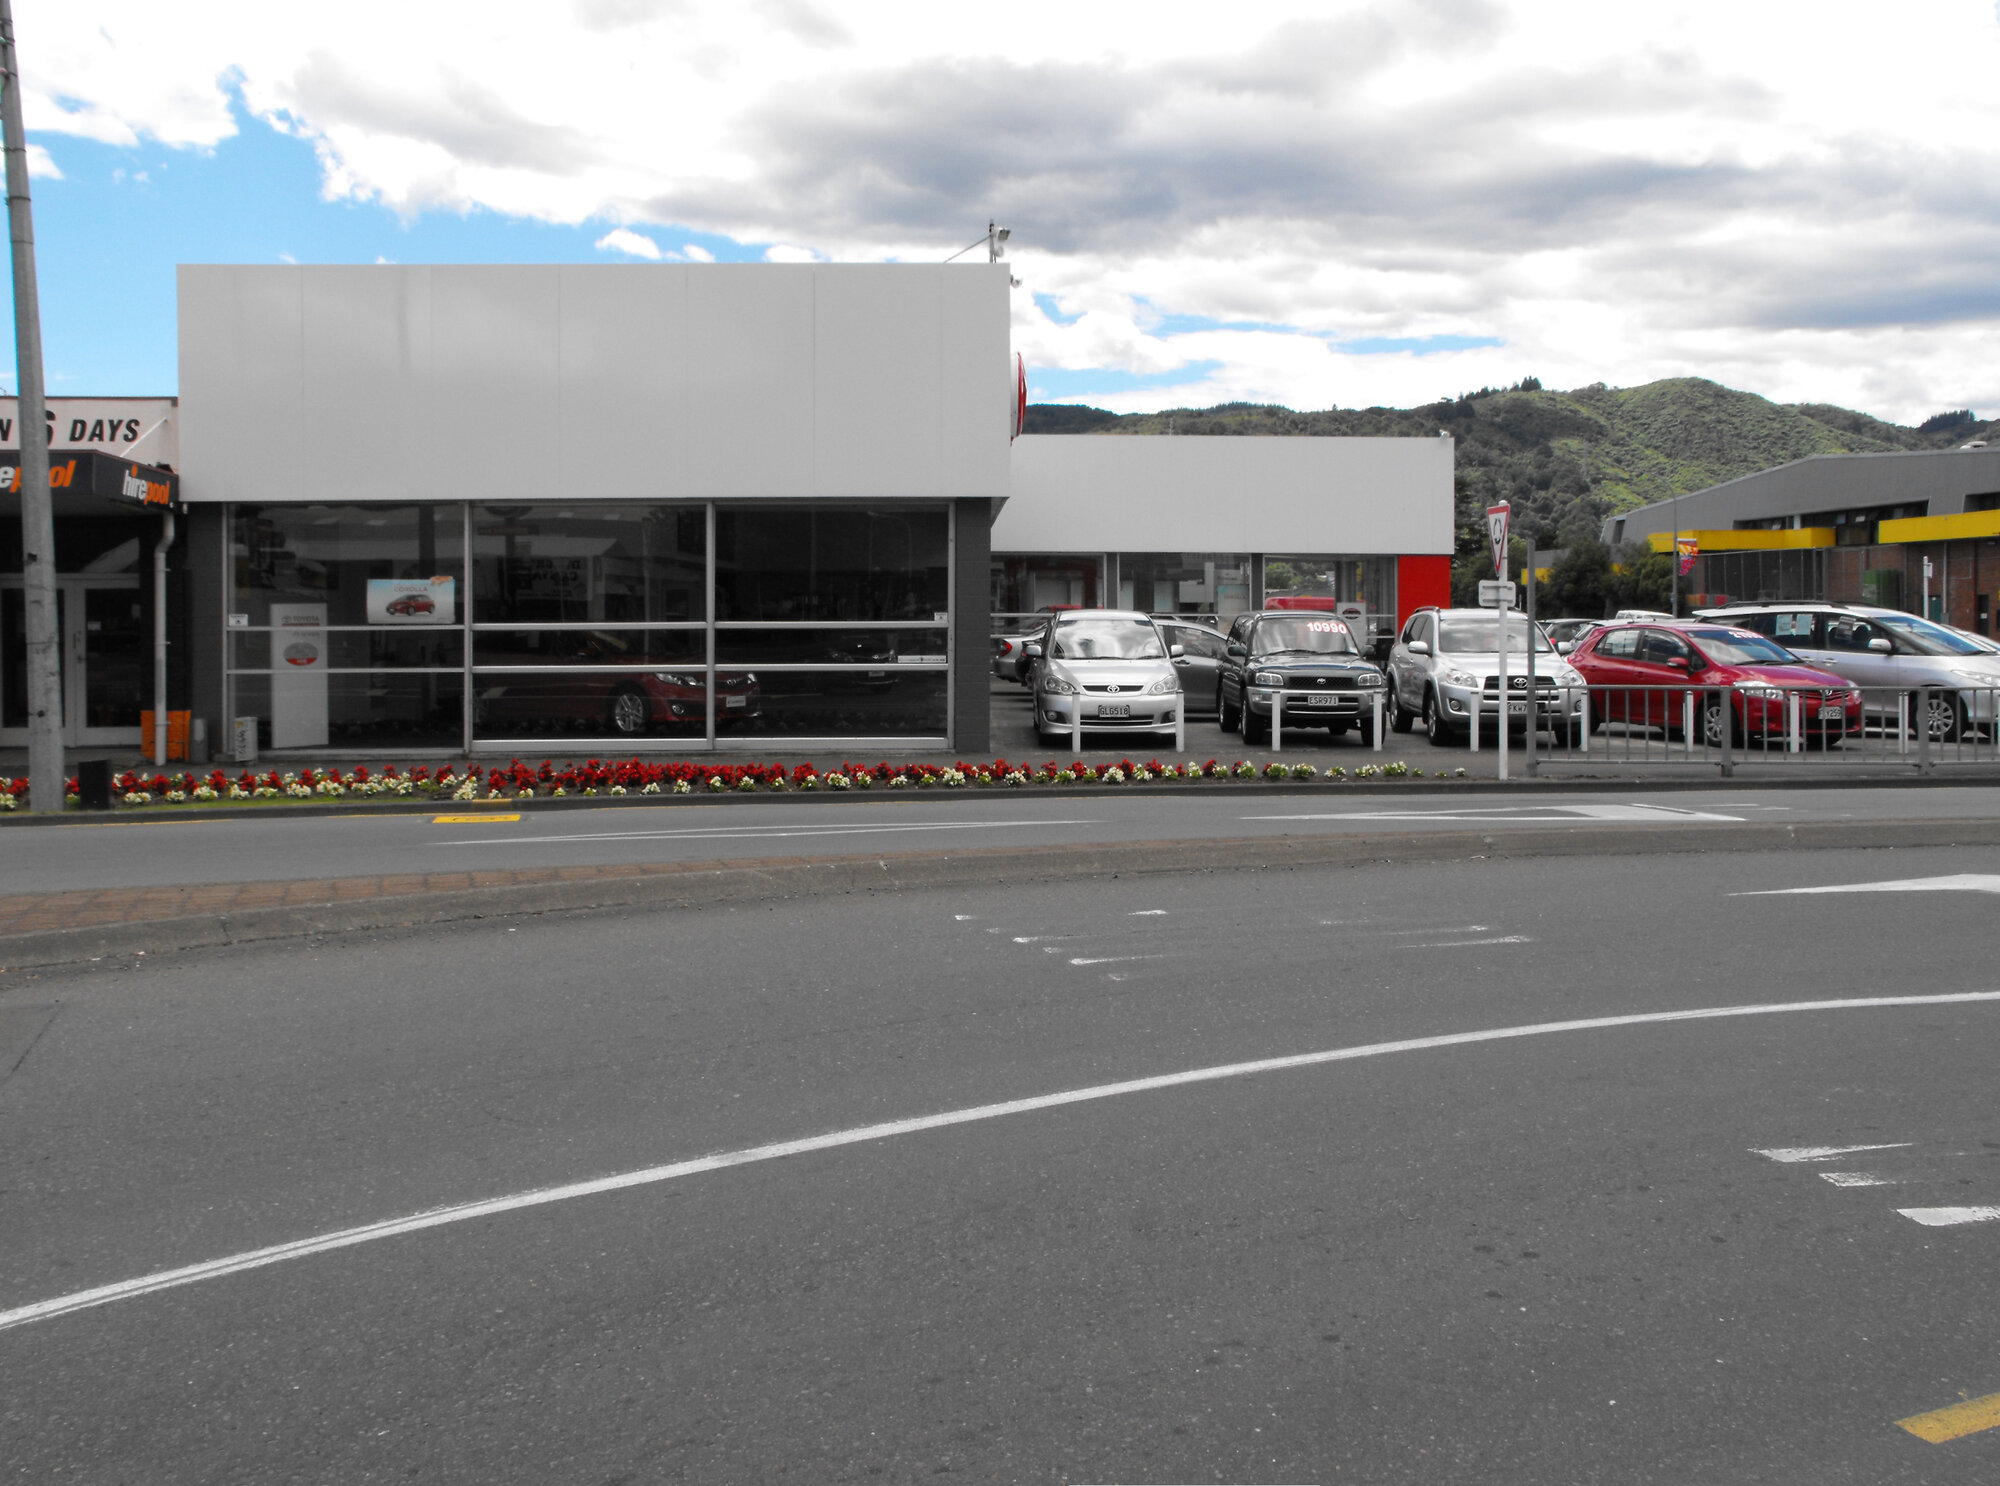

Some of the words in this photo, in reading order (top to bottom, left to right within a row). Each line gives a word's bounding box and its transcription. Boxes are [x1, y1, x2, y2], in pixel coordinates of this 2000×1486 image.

[69, 418, 140, 442] DAYS
[122, 464, 170, 505] hirepool
[1307, 622, 1347, 634] 10990
[1309, 696, 1337, 705] ESR971
